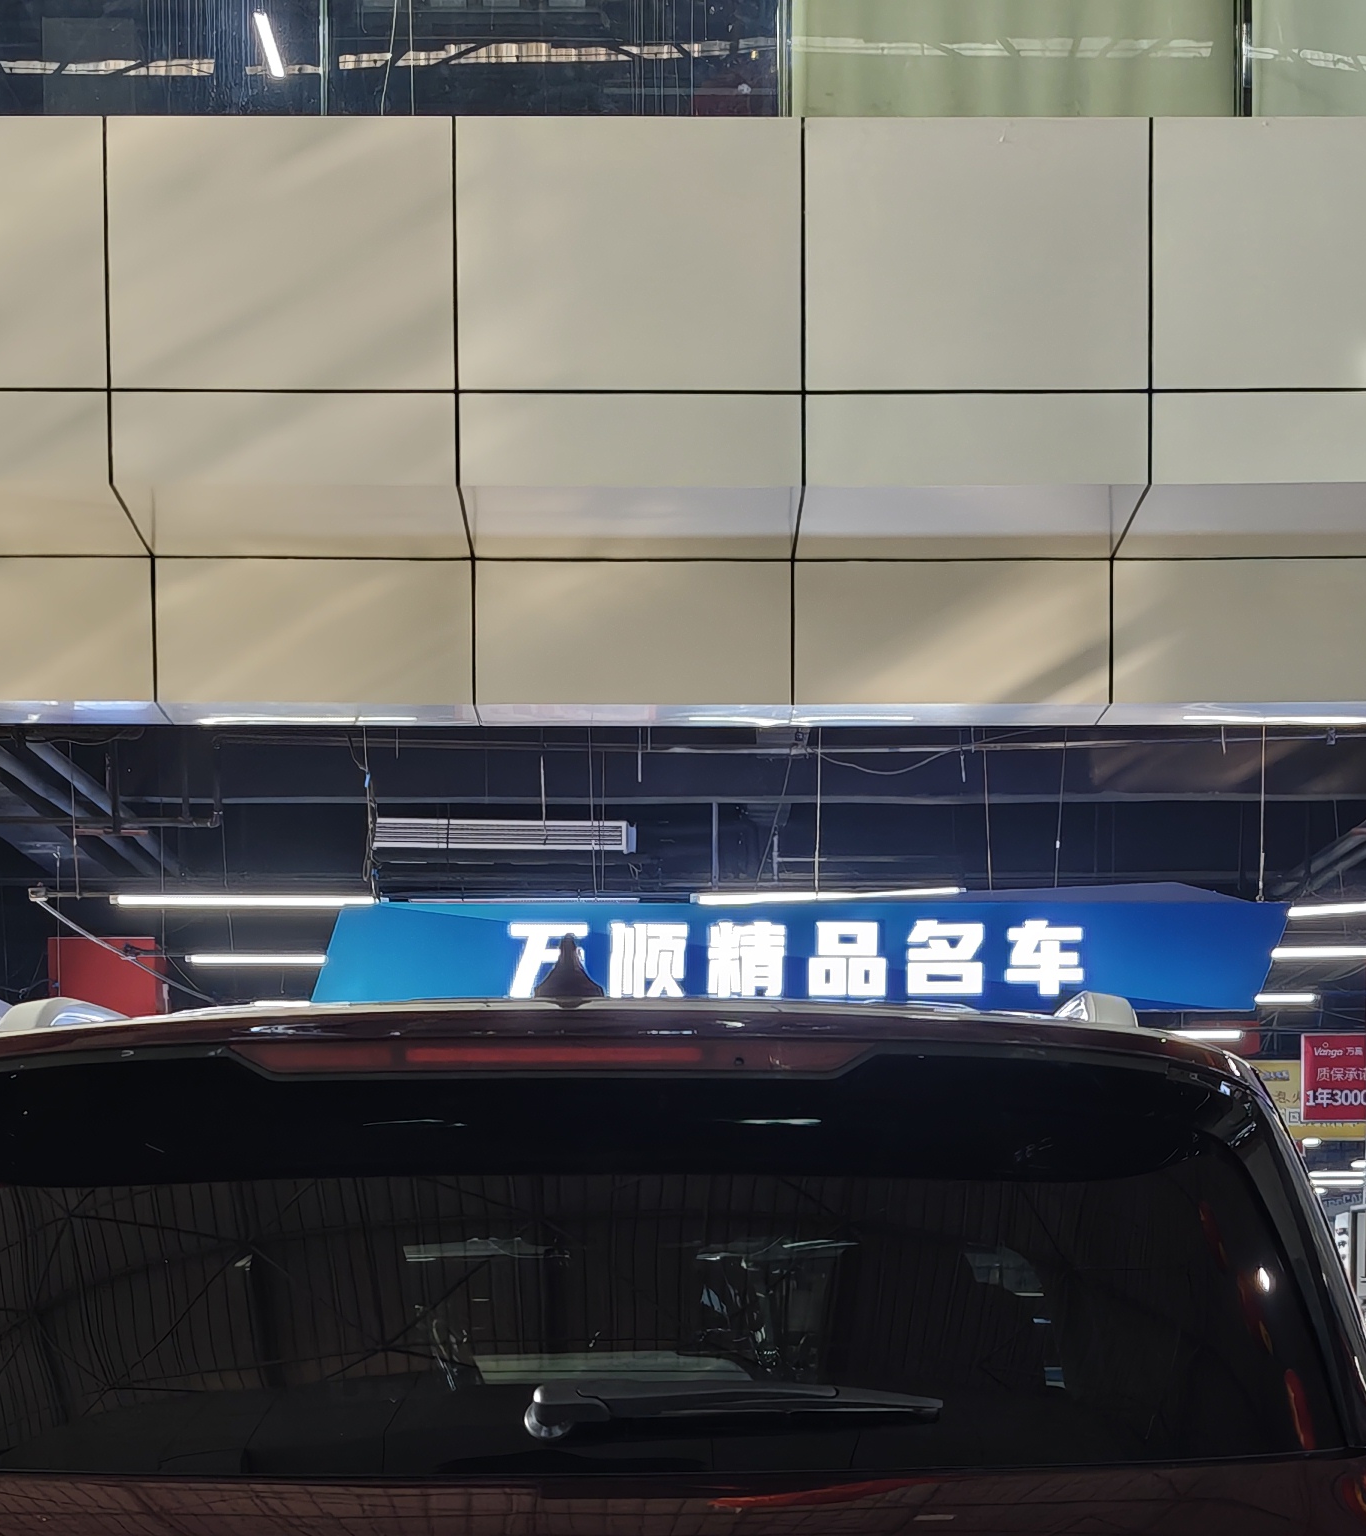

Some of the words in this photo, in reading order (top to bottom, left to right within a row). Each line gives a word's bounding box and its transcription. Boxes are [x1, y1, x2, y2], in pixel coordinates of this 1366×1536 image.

[507, 918, 1085, 999] 万顺精品名车
